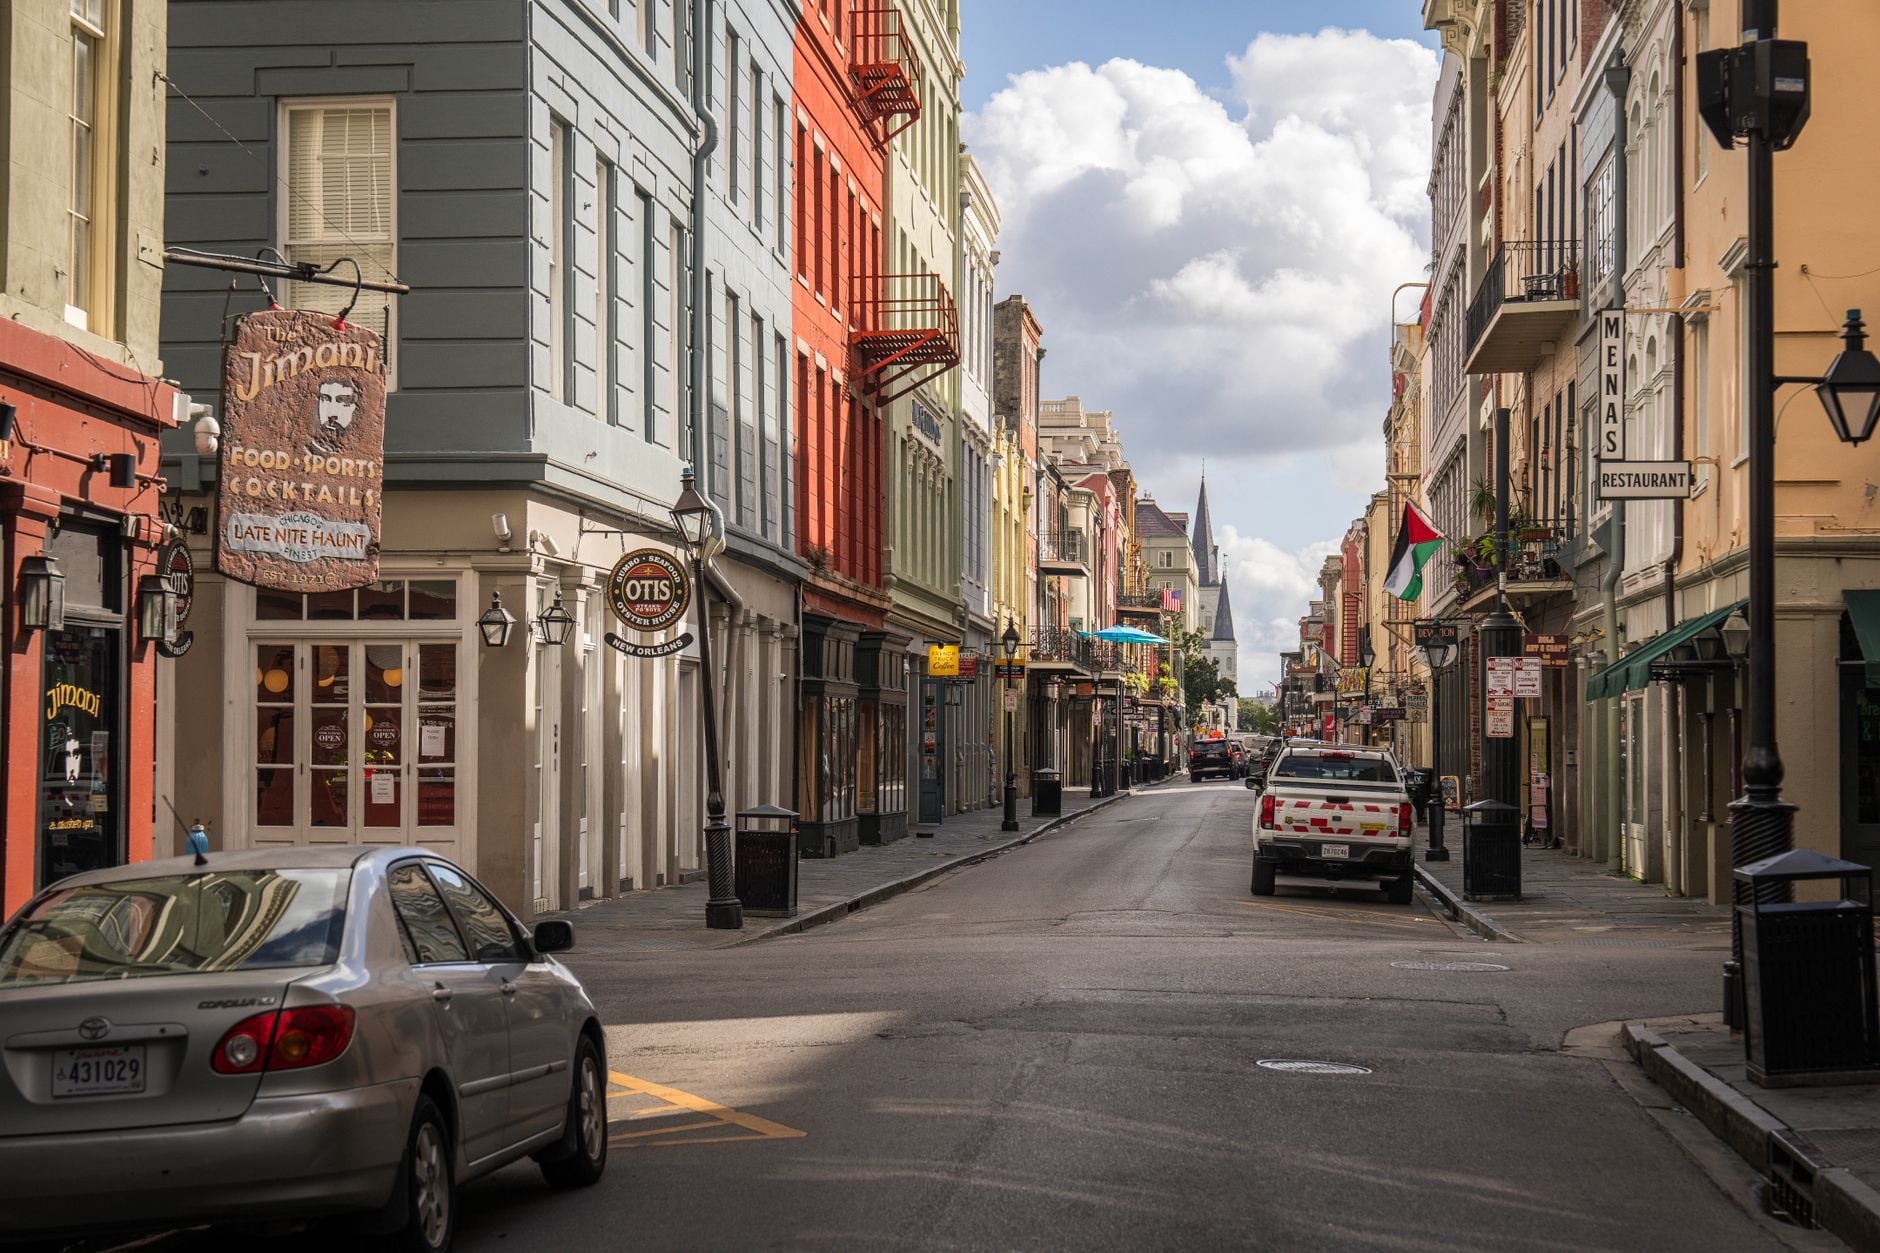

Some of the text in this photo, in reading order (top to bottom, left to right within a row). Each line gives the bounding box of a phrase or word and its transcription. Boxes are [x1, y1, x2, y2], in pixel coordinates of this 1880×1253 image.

[264, 326, 297, 342] The
[1604, 317, 1620, 452] MENAS
[229, 446, 377, 479] FOOD SPORTS
[1602, 472, 1686, 487] RESTAURANT
[229, 477, 375, 507] COCKTAILS
[234, 524, 366, 549] LATE NITE HAUNT
[283, 547, 318, 559] FINEST
[291, 574, 324, 584] 1971
[616, 555, 681, 583] GUMBO SEAFOOD
[170, 572, 188, 595] OTIS
[625, 580, 671, 601] OTIS
[616, 601, 680, 626] OYSTER HOUSE
[1418, 627, 1455, 638] DEVION
[612, 639, 684, 656] NEW ORLEANS
[932, 662, 955, 670] Coffee
[373, 731, 396, 739] OPEN
[69, 1058, 140, 1085] 431029
